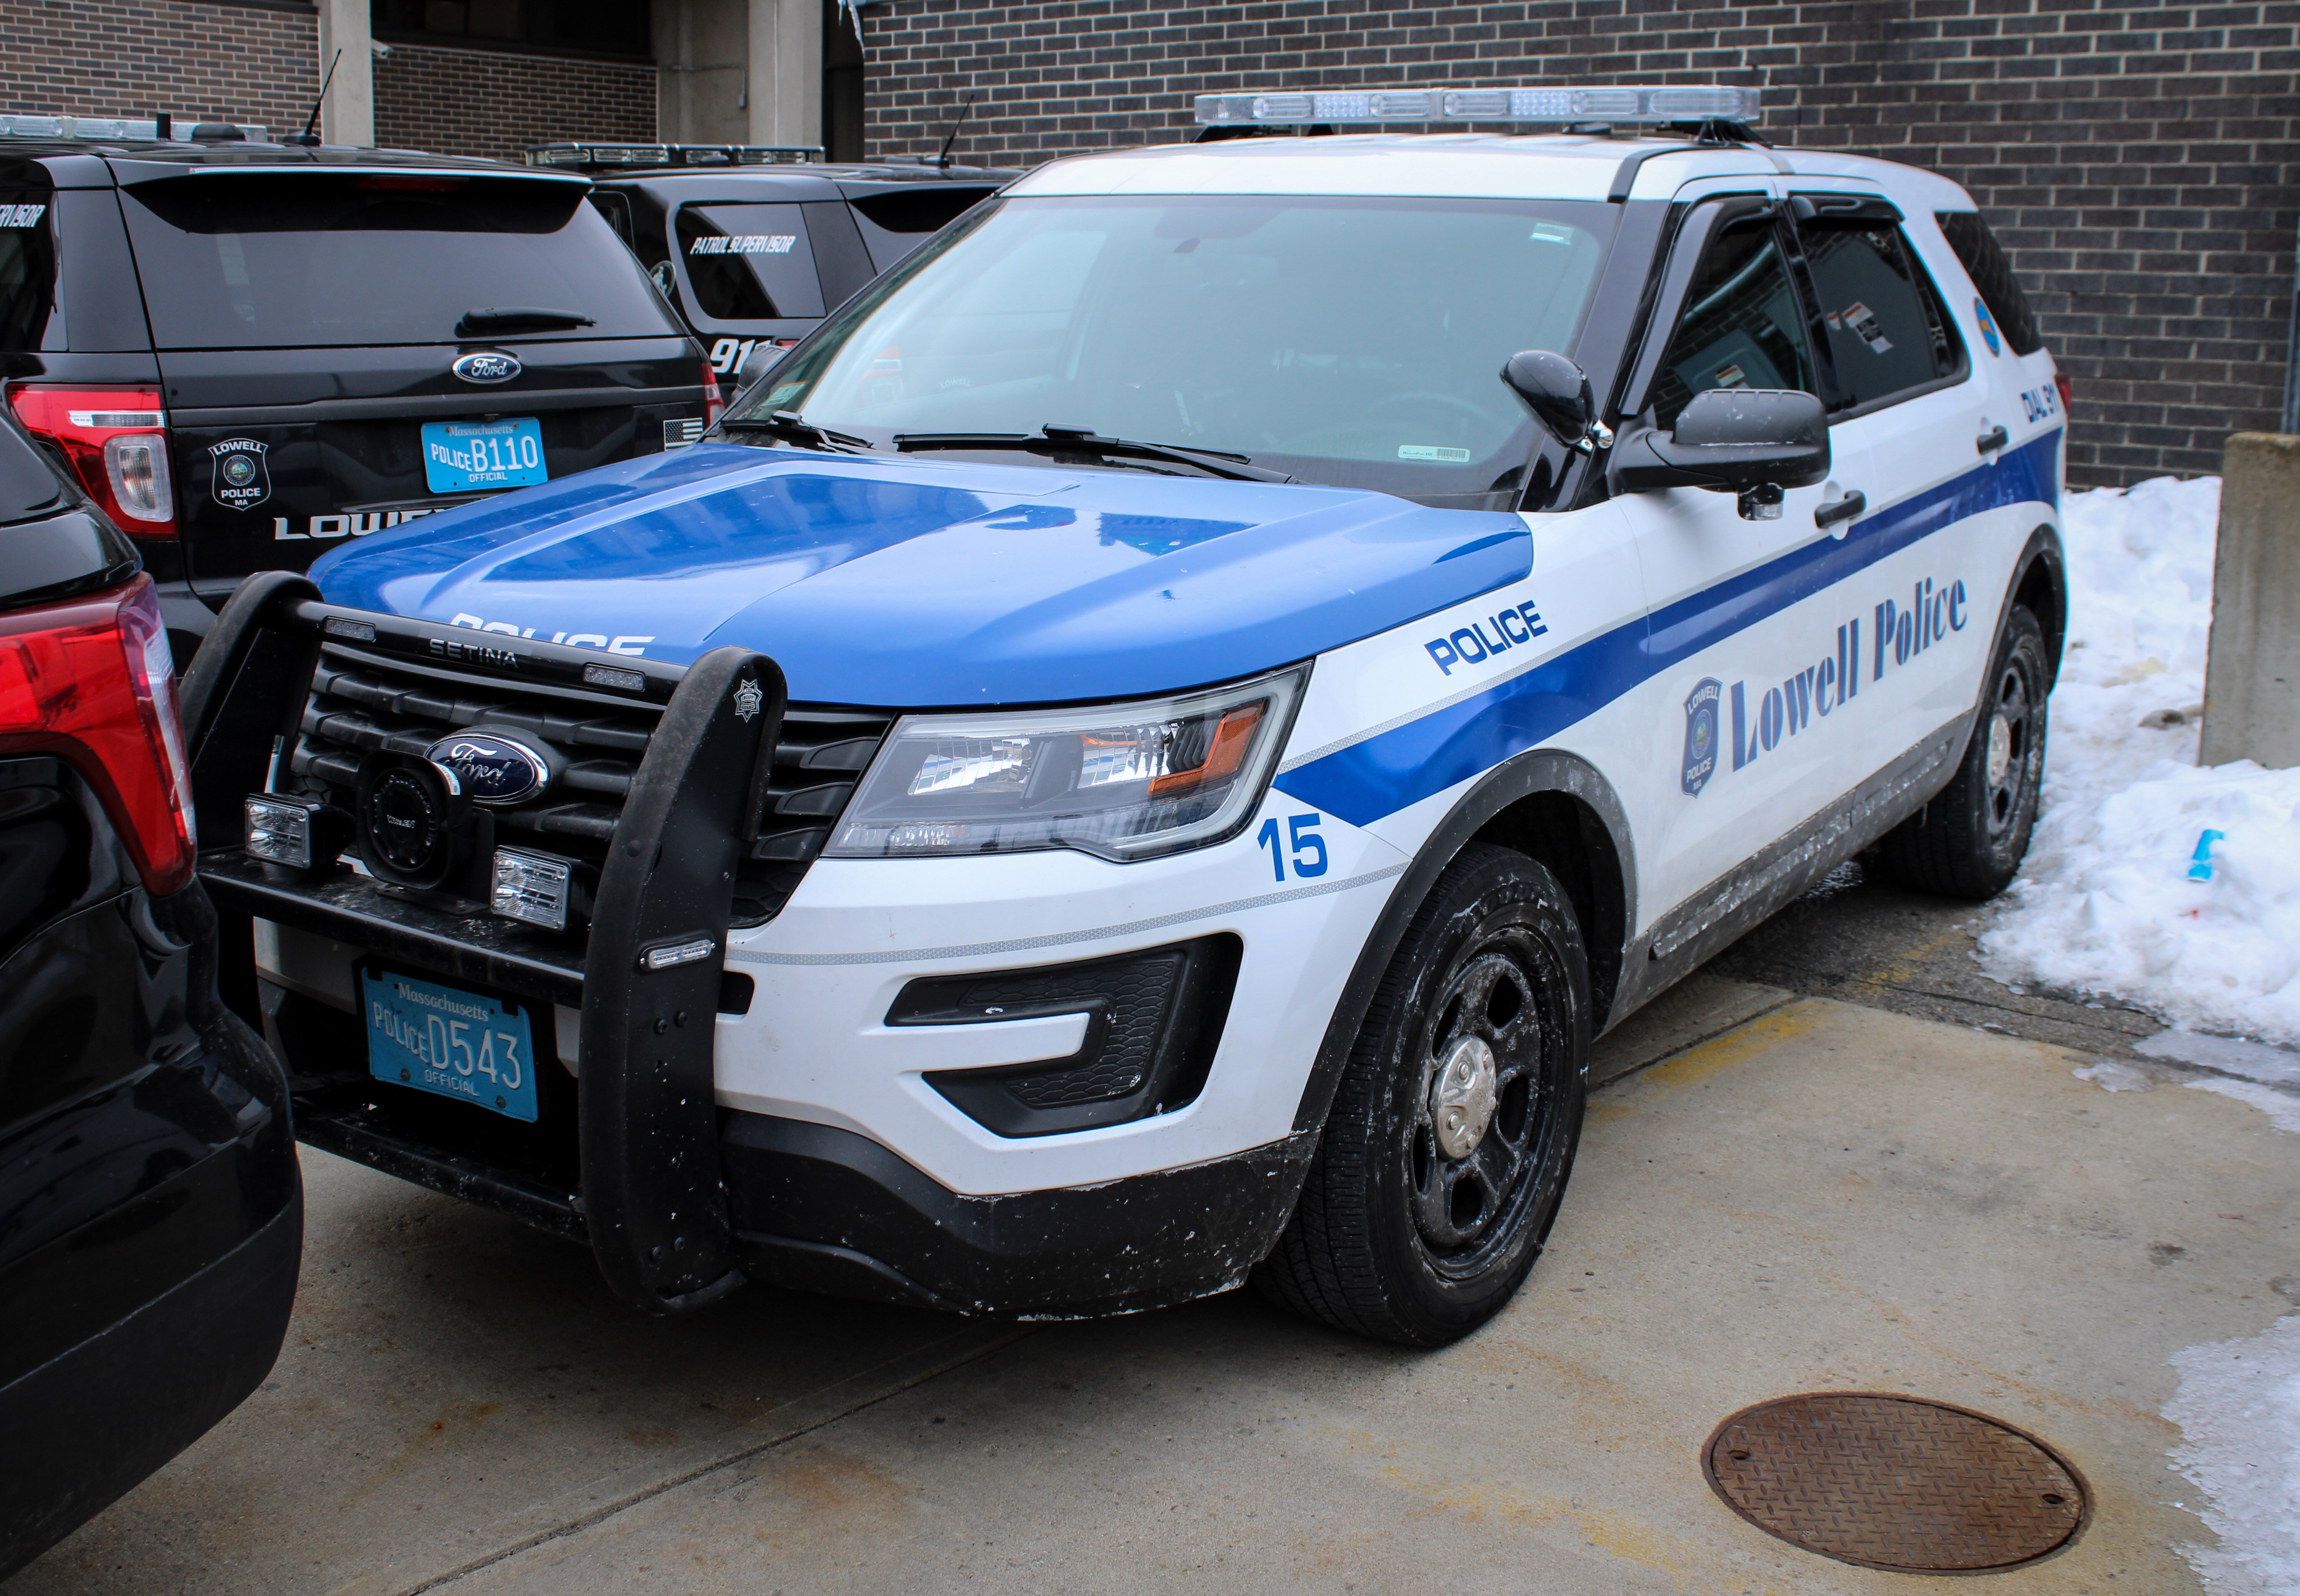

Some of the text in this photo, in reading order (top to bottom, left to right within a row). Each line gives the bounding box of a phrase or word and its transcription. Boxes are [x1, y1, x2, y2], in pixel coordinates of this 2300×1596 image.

[690, 235, 796, 254] PATROL SUPERVISOR
[471, 357, 508, 376] Ford
[710, 338, 771, 374] 91
[2020, 388, 2048, 423] DIAL
[450, 425, 513, 437] Massachusetts
[213, 441, 262, 455] LOWELL
[430, 435, 539, 473] POLICE B110
[468, 471, 508, 483] OFFICIAL
[221, 487, 261, 499] POLICE
[273, 509, 446, 540] LOW
[429, 638, 519, 669] SETINA
[1424, 600, 1548, 676] POLICE
[1730, 576, 1967, 773] Lowell Police
[1687, 685, 1718, 715] LOWELL
[440, 742, 512, 787] Ford
[1687, 757, 1712, 783] POLICE
[386, 814, 416, 829] WHELEN
[1257, 813, 1328, 882] 15
[398, 982, 489, 1022] Massachusetts
[373, 1001, 521, 1089] POLICE D543
[424, 1069, 480, 1096] OFFICIAL
